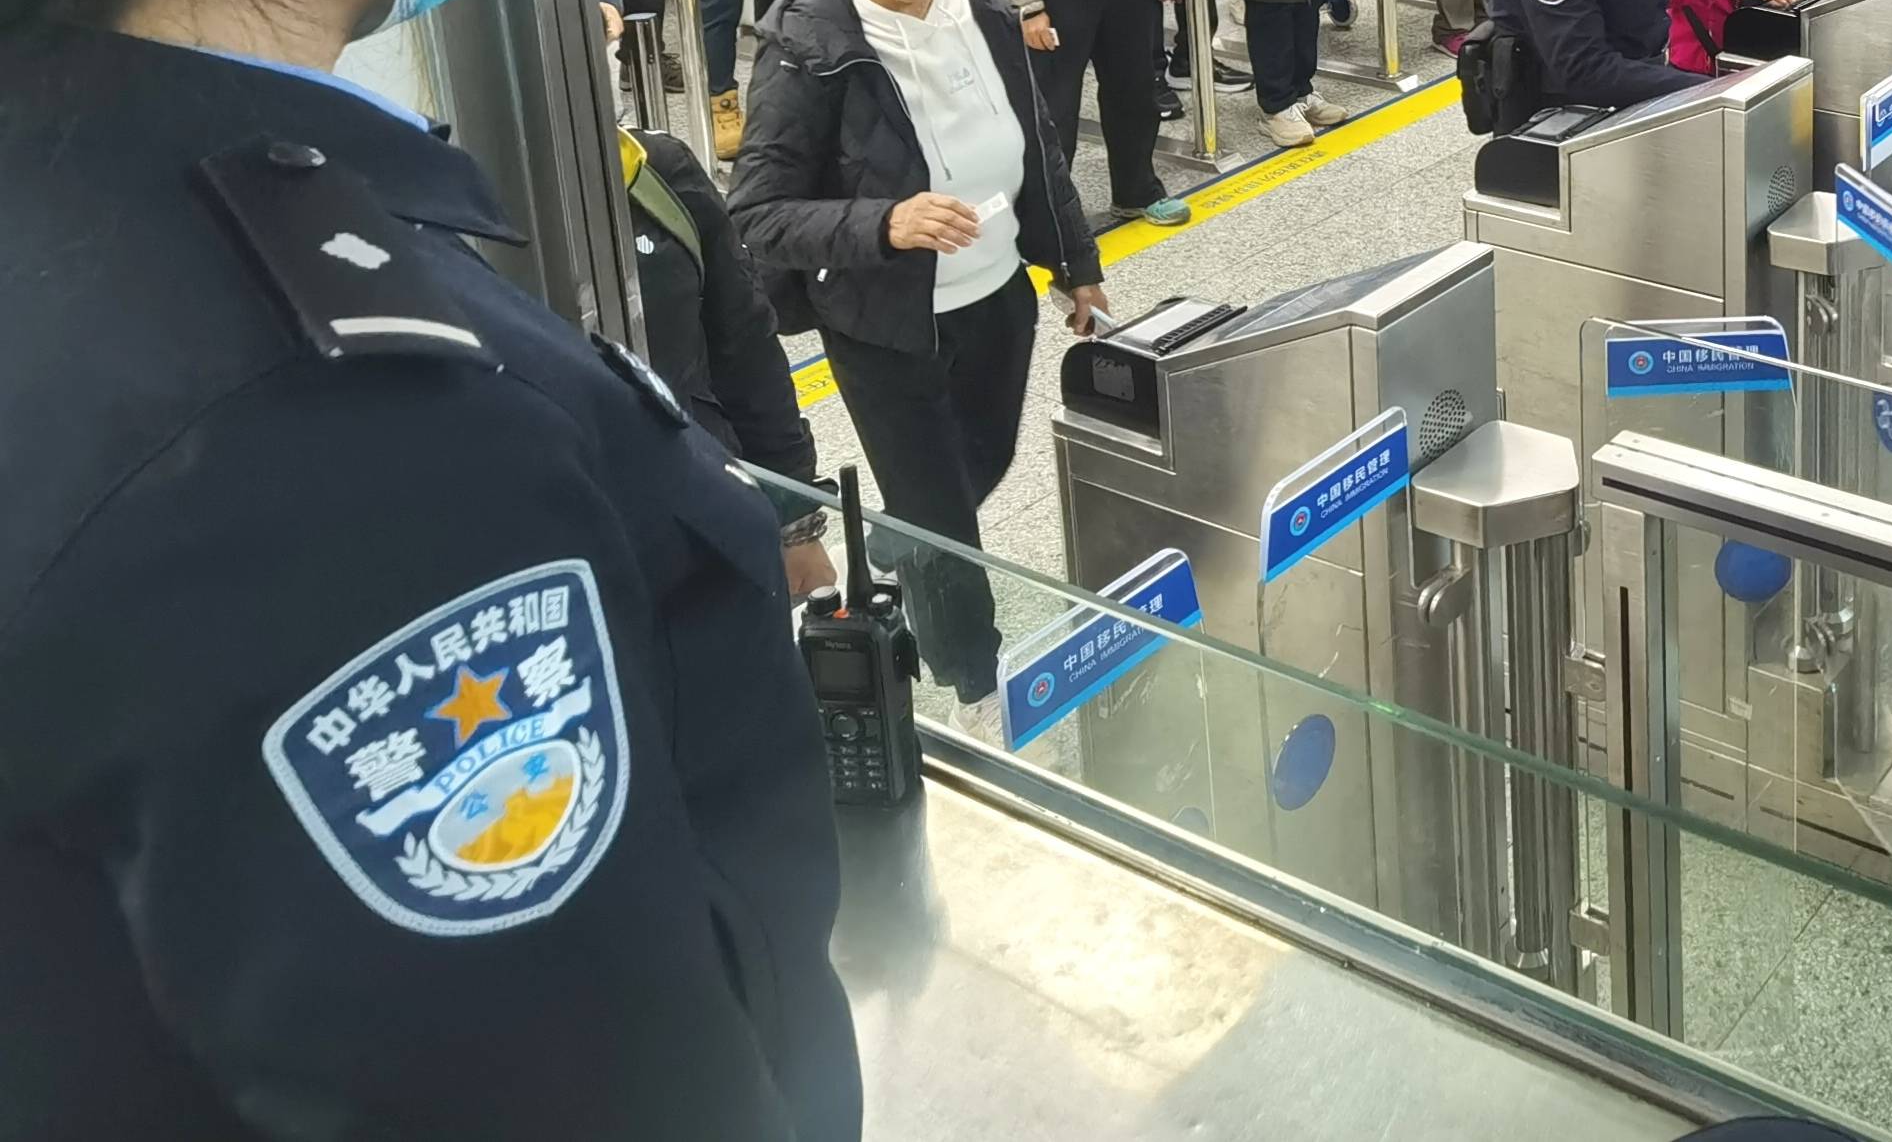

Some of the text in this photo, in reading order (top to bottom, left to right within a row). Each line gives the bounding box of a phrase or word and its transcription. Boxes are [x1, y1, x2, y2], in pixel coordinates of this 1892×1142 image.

[1317, 449, 1390, 508] 中国移民管理
[306, 585, 570, 756] 中华人民共和国
[434, 716, 549, 796] POLICE
